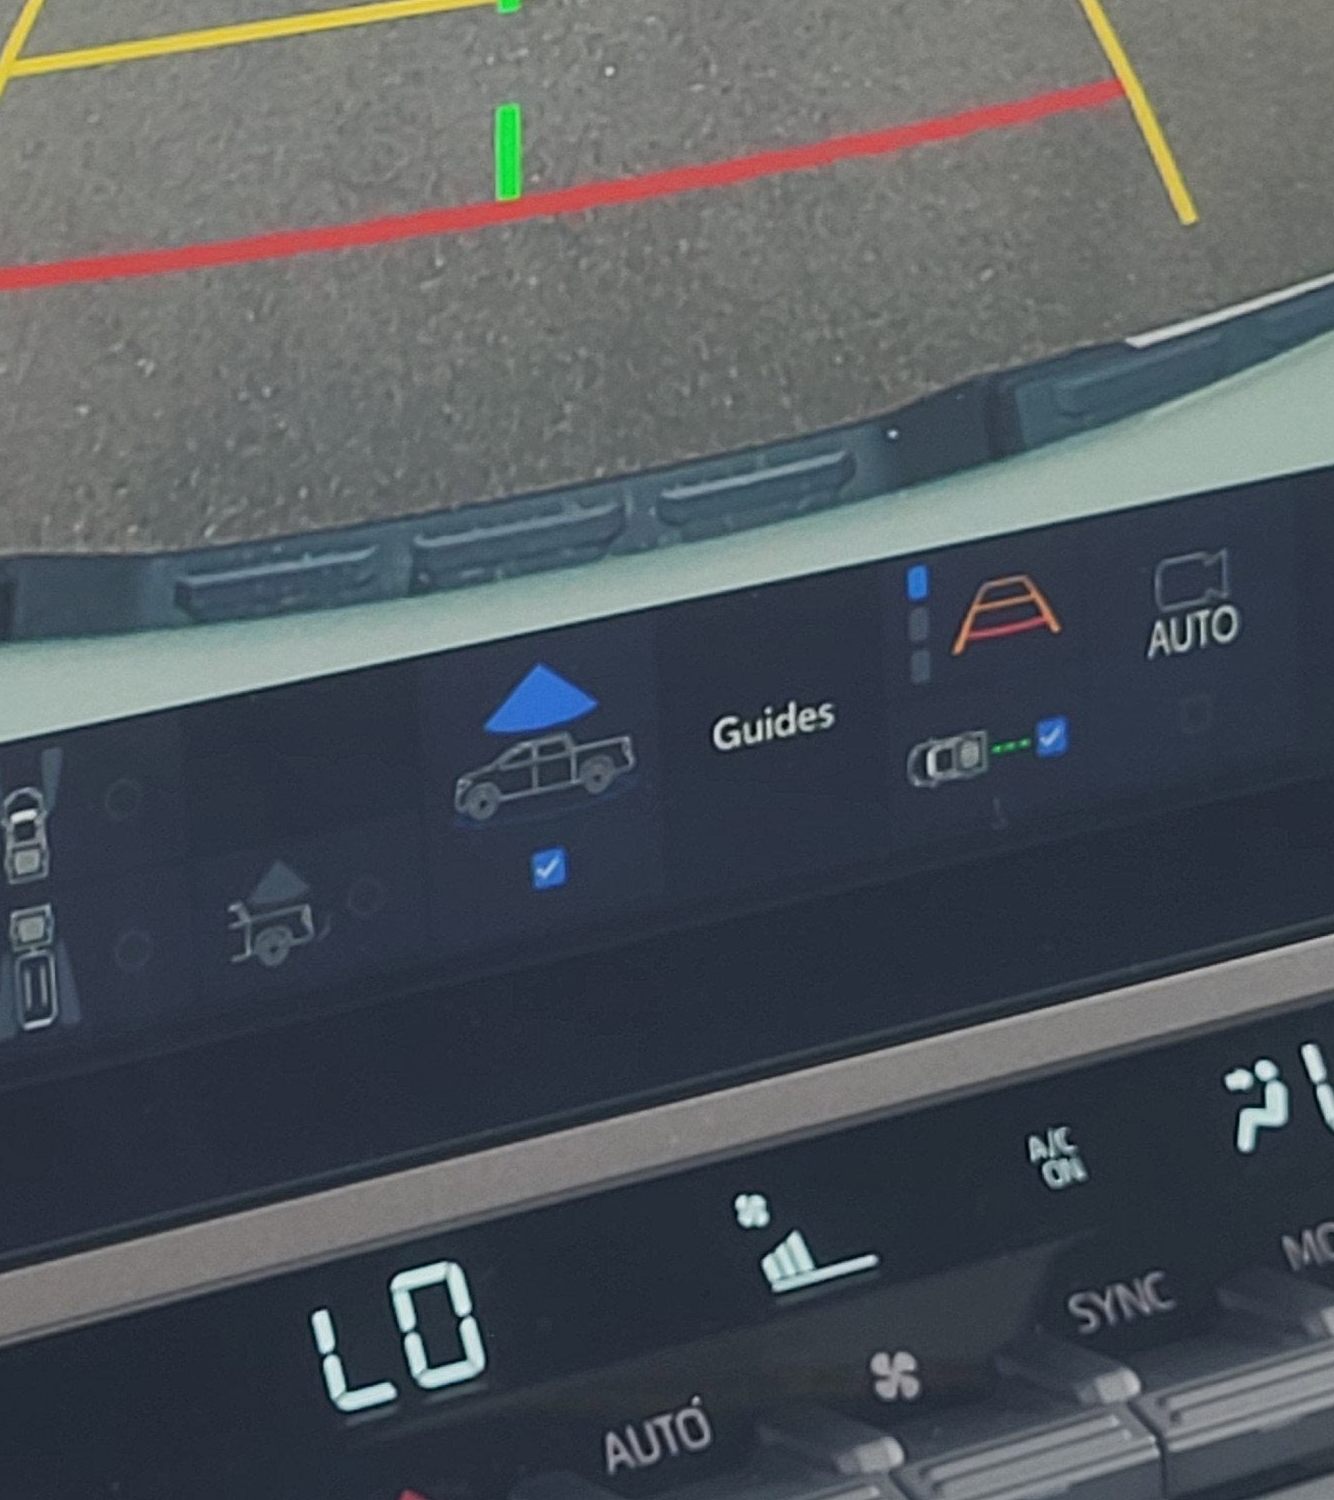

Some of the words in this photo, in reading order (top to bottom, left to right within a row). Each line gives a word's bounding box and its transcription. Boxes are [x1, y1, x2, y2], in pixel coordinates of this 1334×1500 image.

[1147, 604, 1240, 660] AUTO
[712, 700, 836, 751] Guides
[1027, 1125, 1080, 1164] A/C
[1041, 1156, 1088, 1190] ON
[1067, 1270, 1177, 1335] SYNC
[310, 1259, 487, 1414] LO
[603, 1403, 713, 1475] AUTO
